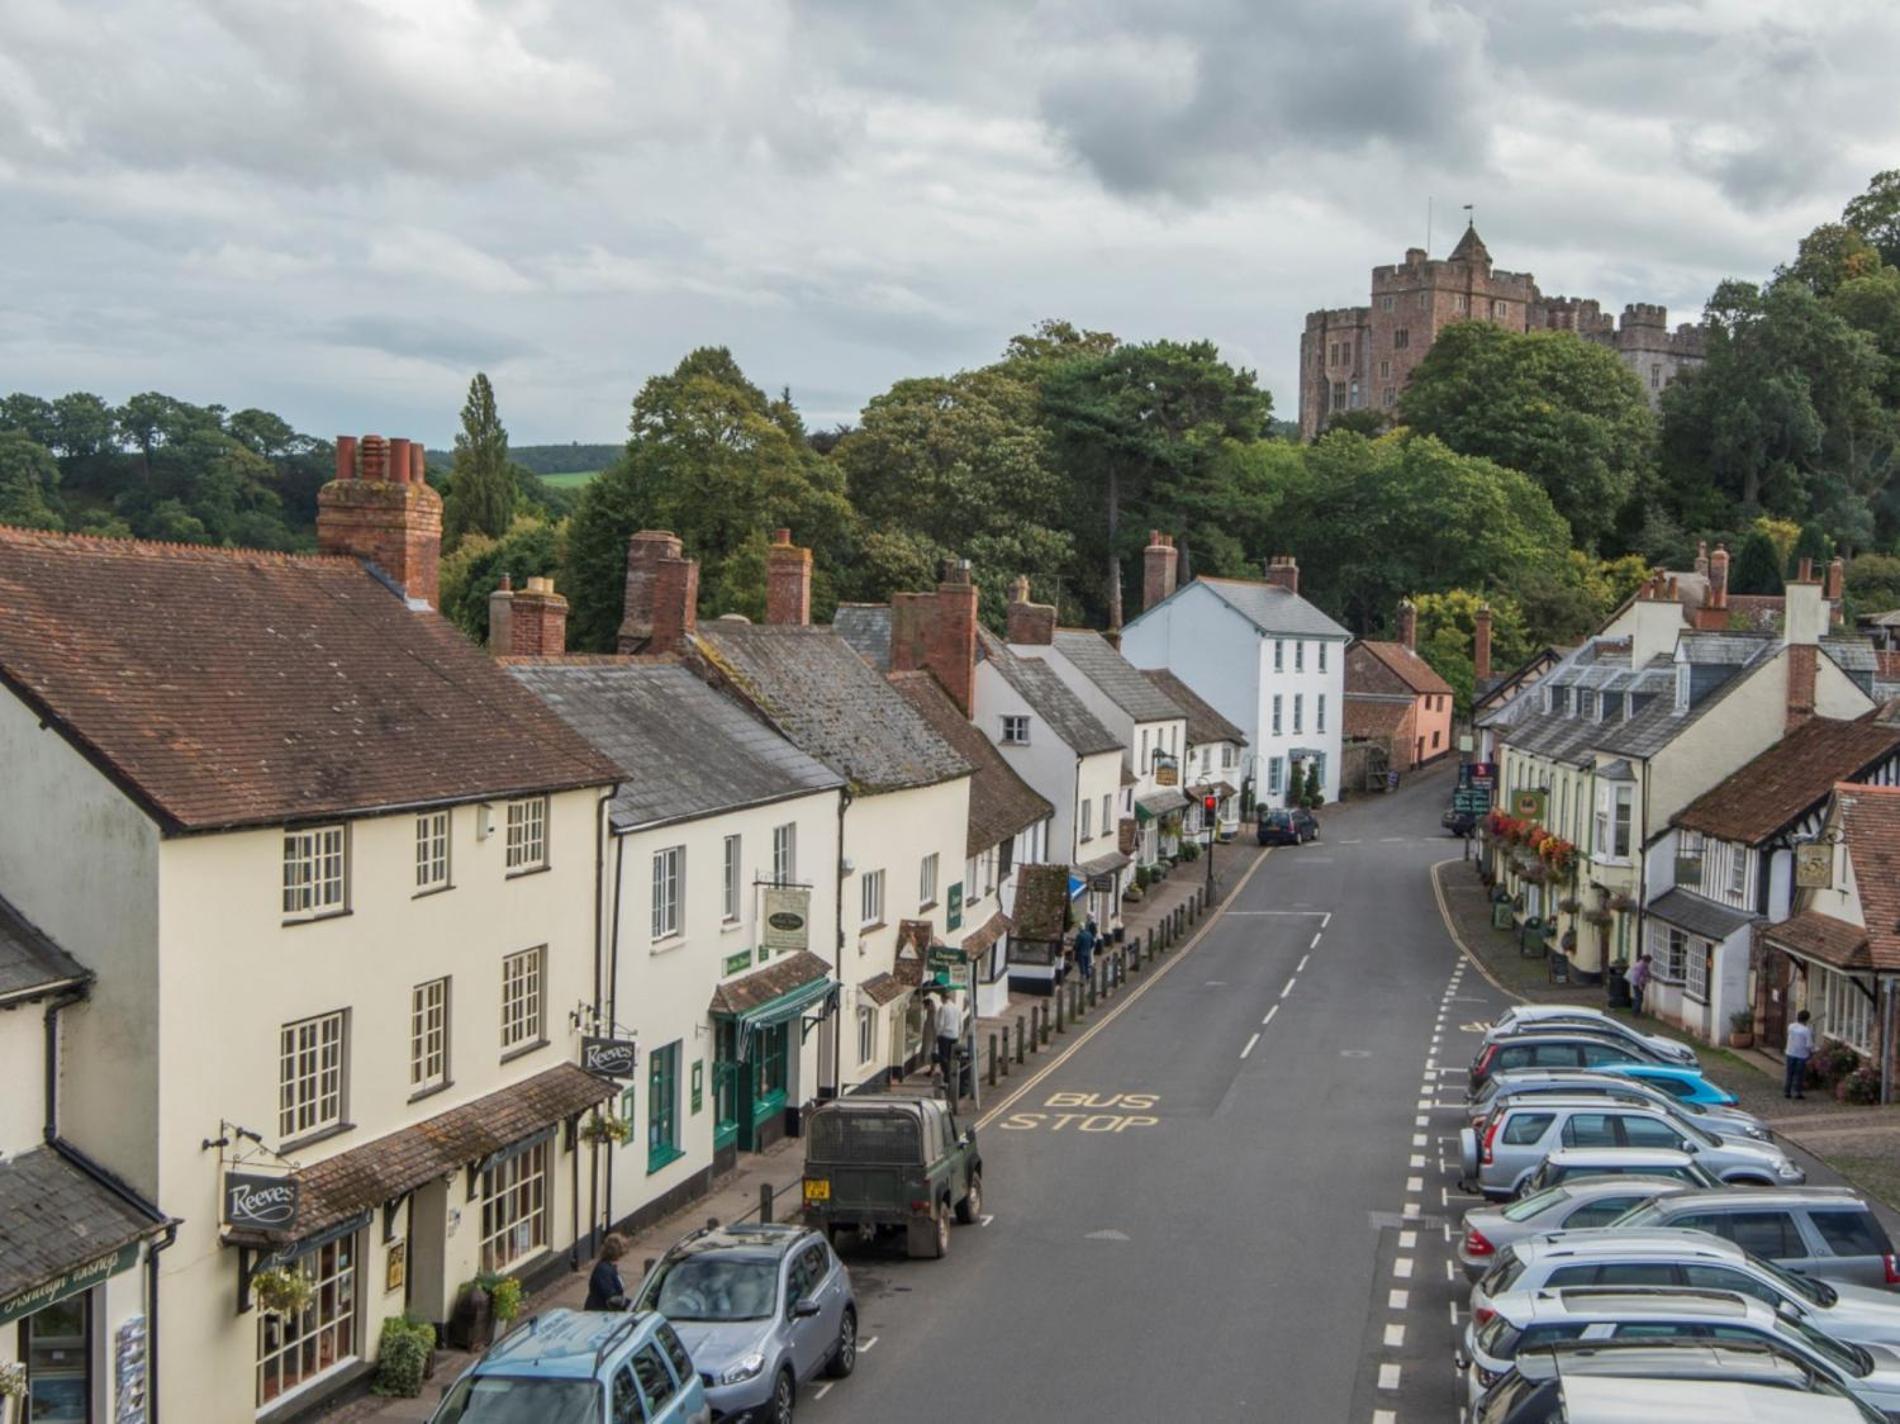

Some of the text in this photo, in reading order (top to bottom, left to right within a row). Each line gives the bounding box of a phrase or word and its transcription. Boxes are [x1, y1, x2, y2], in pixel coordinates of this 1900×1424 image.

[586, 1044, 632, 1072] Reeves
[1044, 1092, 1160, 1109] BUS
[1000, 1113, 1159, 1132] STOP
[229, 1184, 295, 1222] Reeves
